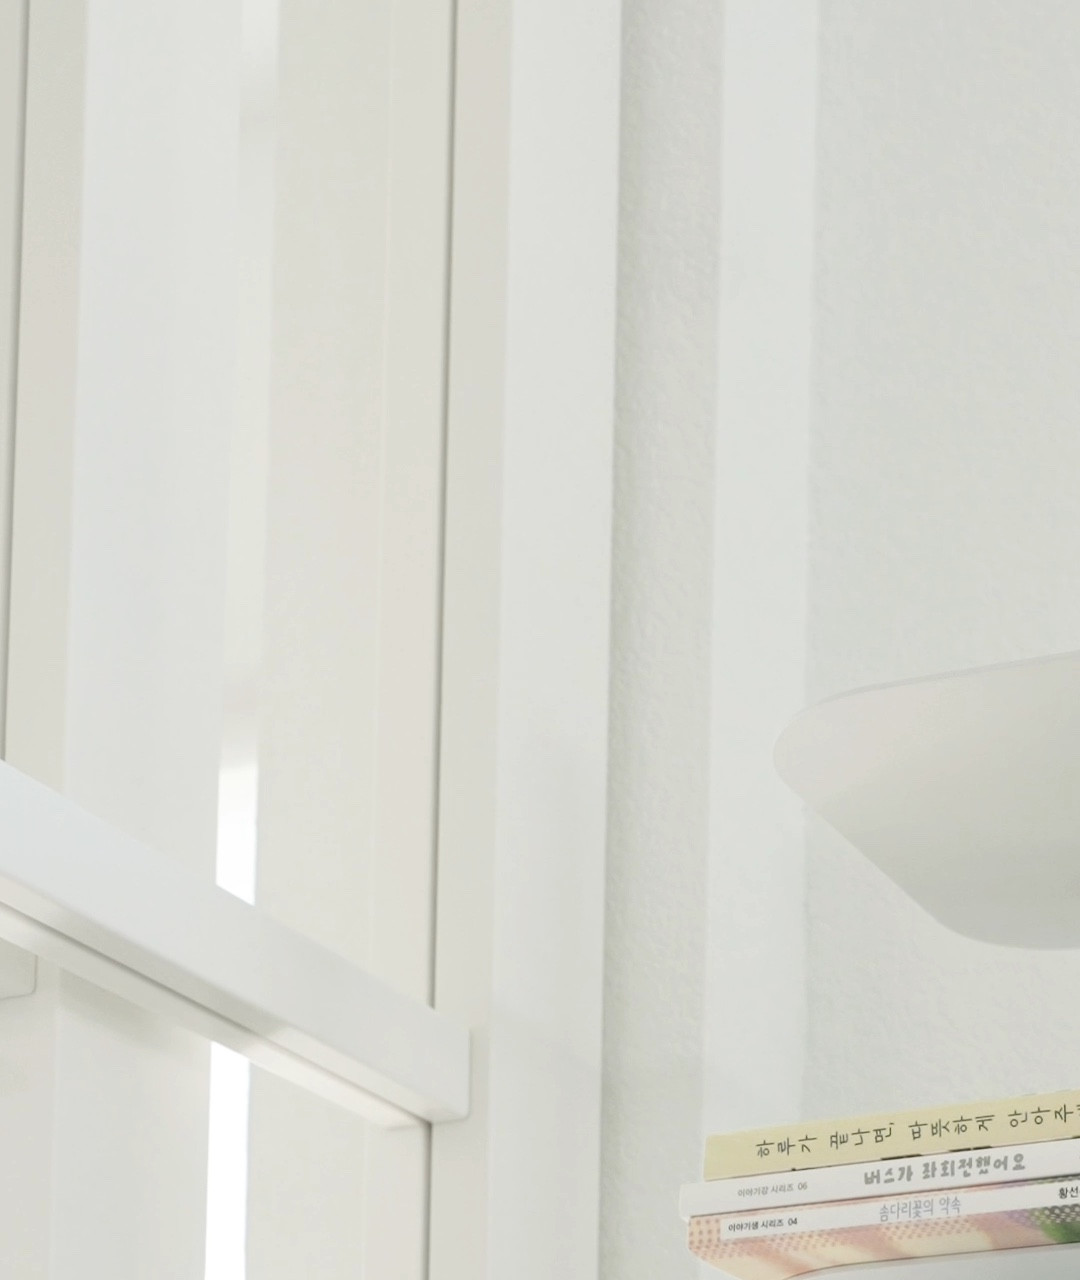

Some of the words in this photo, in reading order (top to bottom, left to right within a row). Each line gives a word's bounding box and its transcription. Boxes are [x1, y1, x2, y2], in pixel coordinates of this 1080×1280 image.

[756, 1134, 817, 1158] 하루가
[830, 1122, 894, 1150] 끝나면,
[908, 1114, 995, 1140] 따뜻하게
[864, 1165, 914, 1185] 버스가
[922, 1153, 1026, 1179] 좌회전했어요
[771, 1183, 794, 1194] 시리즈
[797, 1182, 808, 1191] 06
[939, 1195, 962, 1216] 약속
[761, 1218, 784, 1229] 시리즈
[788, 1217, 798, 1226] 04
